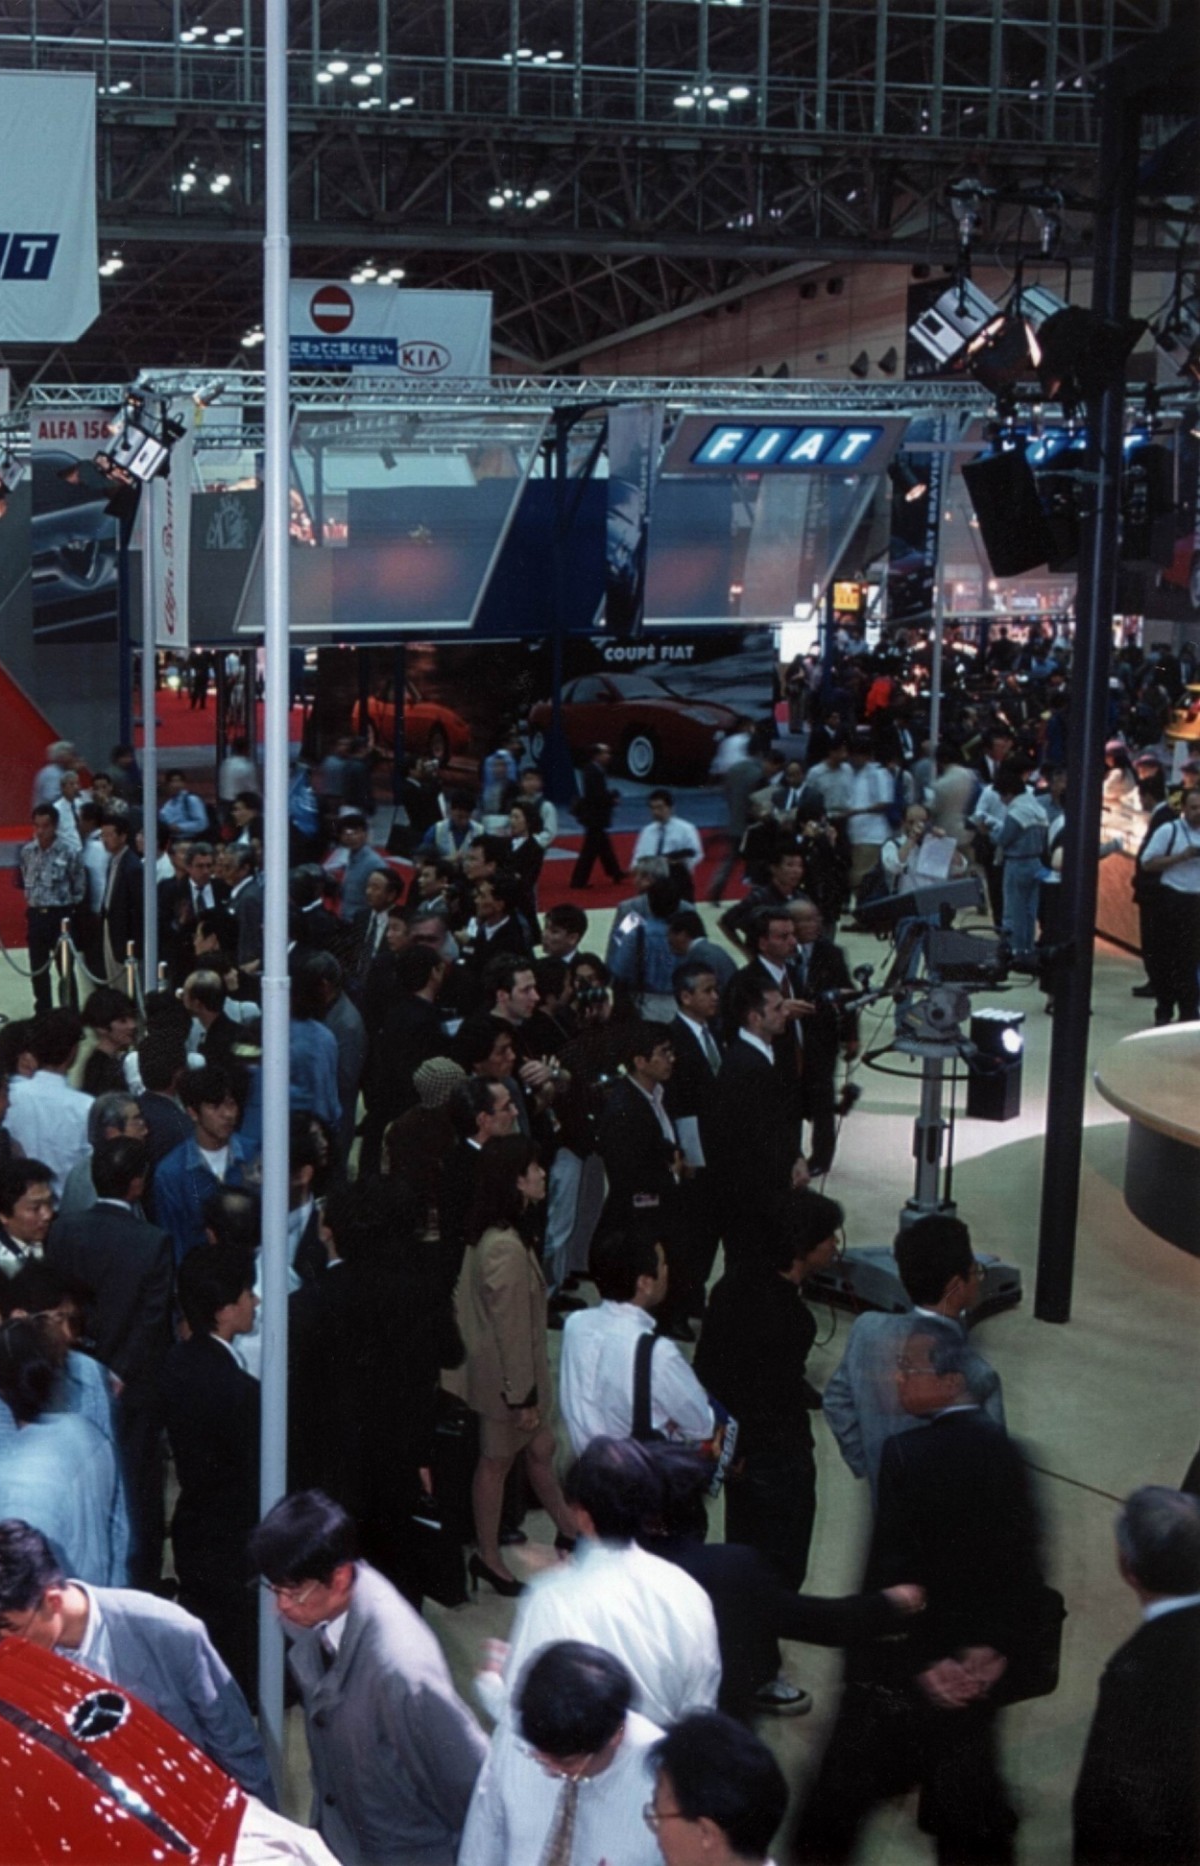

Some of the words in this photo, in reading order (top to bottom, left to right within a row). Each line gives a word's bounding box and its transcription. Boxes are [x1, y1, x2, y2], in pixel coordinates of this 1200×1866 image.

[402, 349, 442, 366] KIA
[38, 420, 77, 439] ALFA
[83, 420, 111, 439] 156
[706, 431, 873, 461] FIAT
[923, 530, 936, 567] FIAT
[660, 645, 695, 660] FIAT
